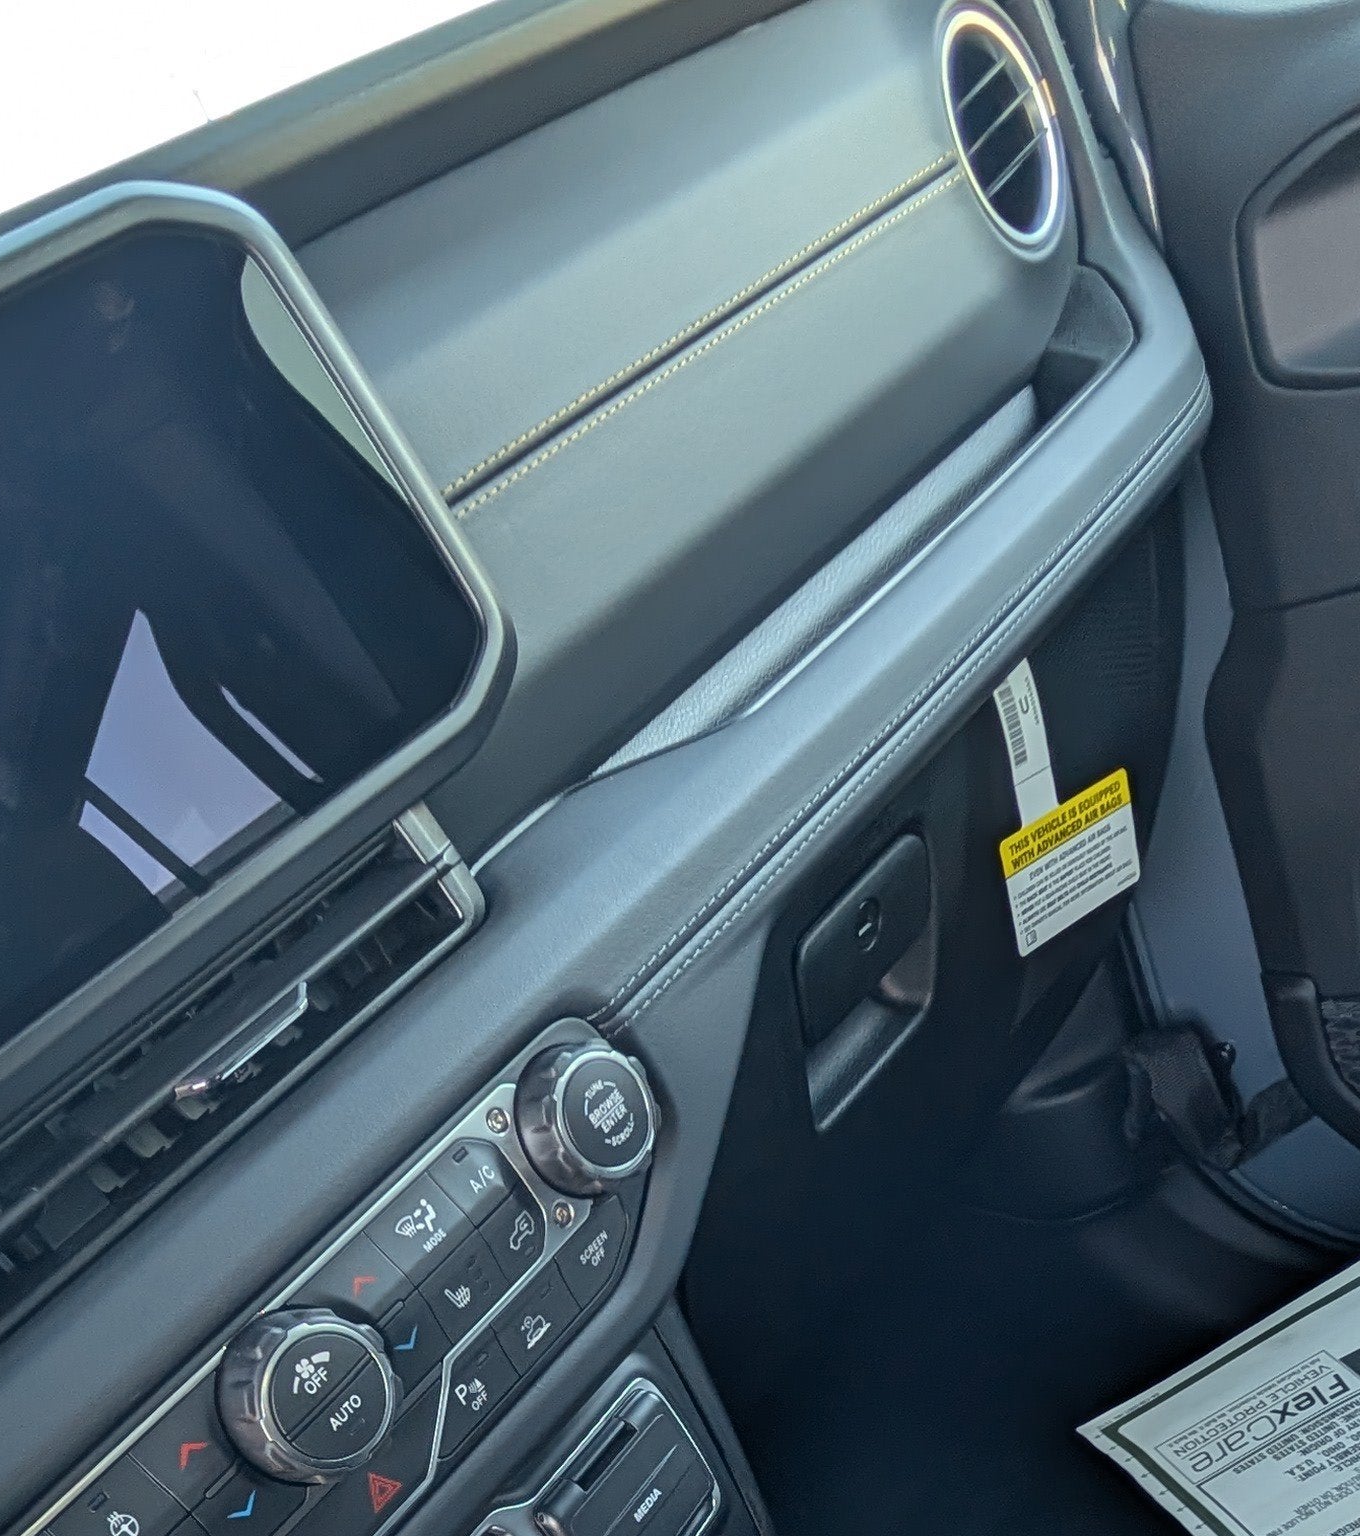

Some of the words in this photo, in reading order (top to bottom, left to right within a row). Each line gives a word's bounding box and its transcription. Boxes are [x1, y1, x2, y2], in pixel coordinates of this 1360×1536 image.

[1008, 835, 1029, 855] THIS
[1030, 811, 1067, 842] VEHICLE
[1068, 806, 1077, 819] IS
[1078, 780, 1120, 814] EQUIPPED
[1010, 847, 1035, 869] WITH
[1036, 818, 1082, 855] ADVANCED
[1084, 808, 1098, 824] AIR
[1099, 793, 1122, 815] BAGS
[585, 1079, 603, 1100] TUNE
[589, 1089, 624, 1125] BROWSE
[600, 1107, 628, 1133] ENTER
[469, 1165, 496, 1194] A/C
[423, 1227, 447, 1253] MODE
[580, 1230, 608, 1265] SCREEN
[591, 1246, 605, 1266] OFF
[304, 1366, 328, 1394] OFF
[1265, 1364, 1331, 1404] VEHICLE
[329, 1394, 362, 1431] AUTO
[471, 1391, 488, 1411] OFF
[1172, 1399, 1267, 1457] PROTECTION
[1188, 1370, 1350, 1480] FlexCare
[633, 1488, 662, 1523] MEDIA
